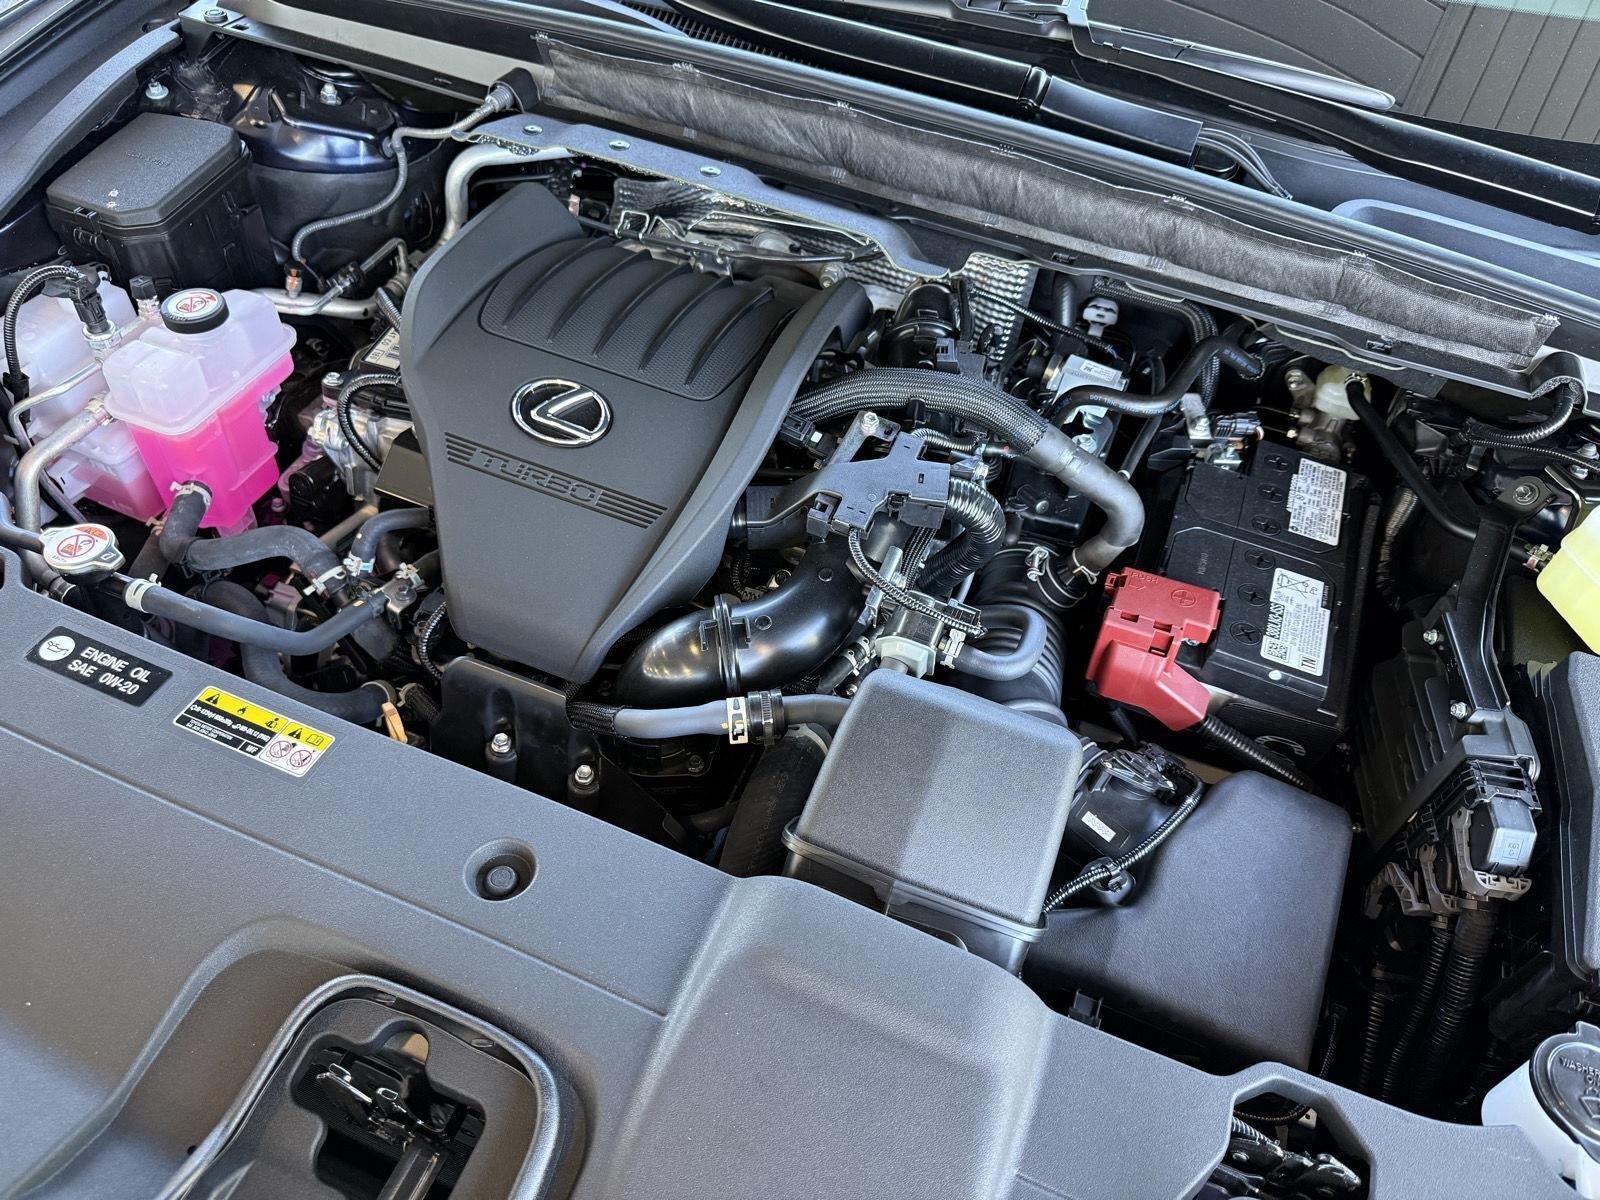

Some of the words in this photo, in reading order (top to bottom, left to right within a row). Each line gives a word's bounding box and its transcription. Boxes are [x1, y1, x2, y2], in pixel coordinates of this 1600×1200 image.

[479, 449, 598, 503] TURBO
[67, 659, 98, 677] SAE
[98, 672, 140, 695] 0W-20
[80, 646, 130, 672] ENGINE
[129, 667, 151, 683] OIL
